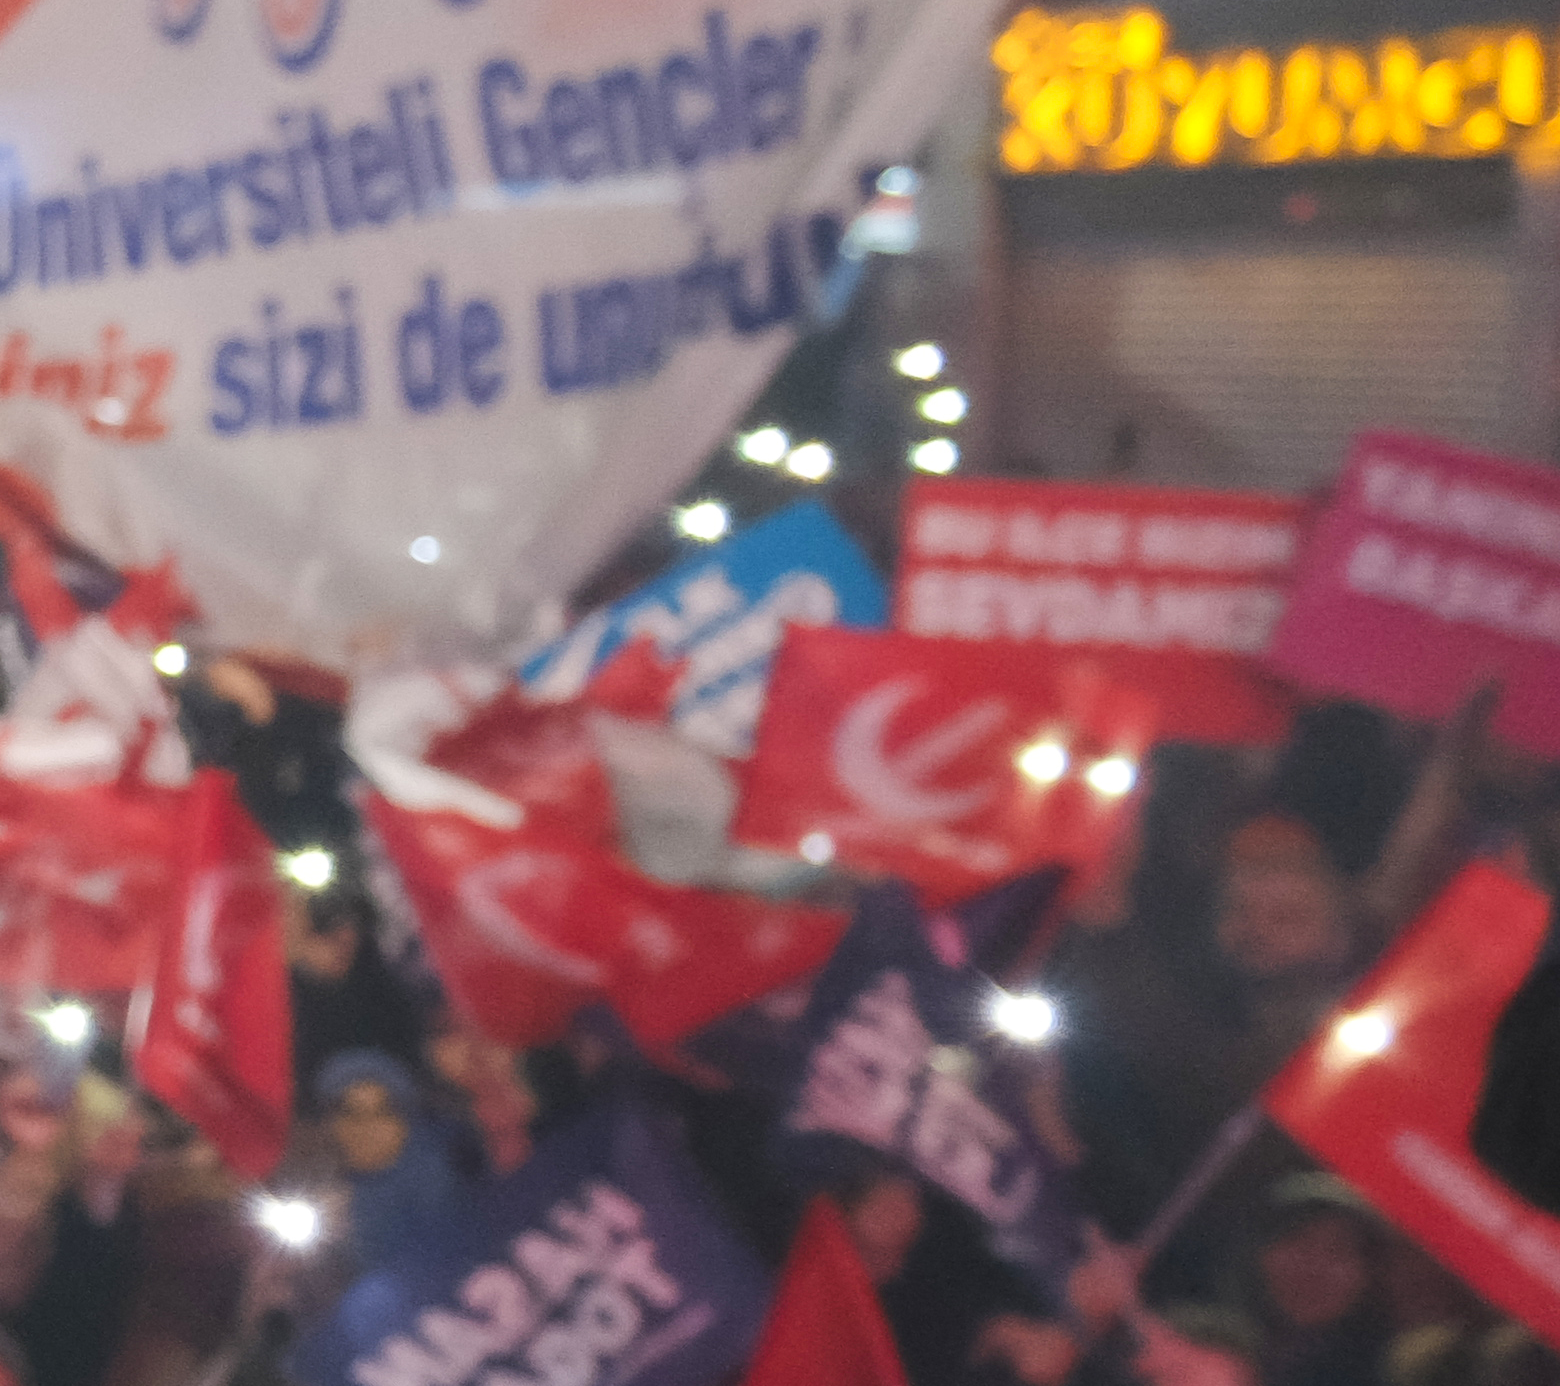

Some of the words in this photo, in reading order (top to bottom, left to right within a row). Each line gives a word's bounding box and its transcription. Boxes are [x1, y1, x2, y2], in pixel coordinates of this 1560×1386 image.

[477, 7, 820, 213] Gençler
[208, 298, 363, 436] sizi
[397, 271, 507, 407] de
